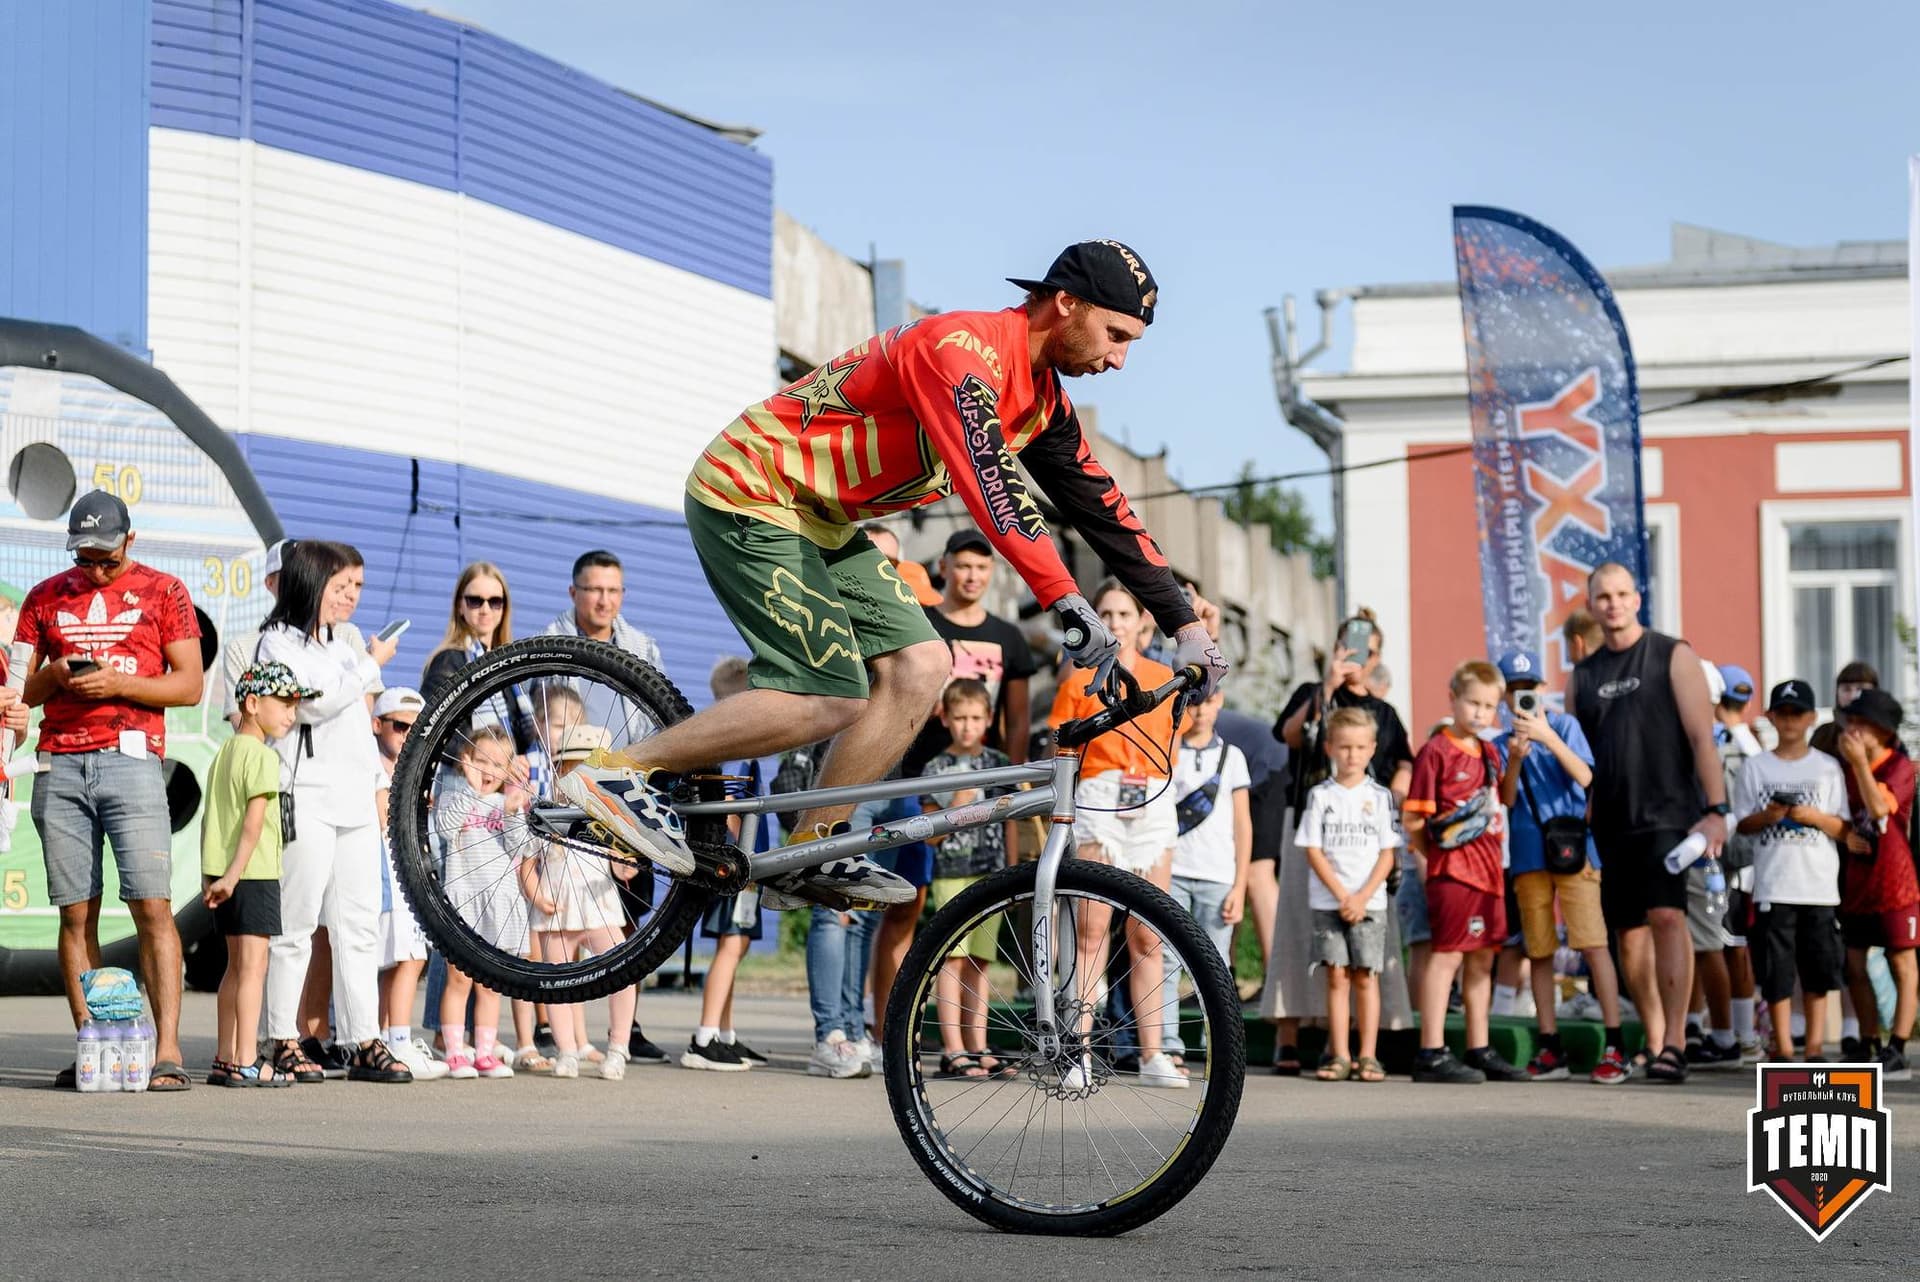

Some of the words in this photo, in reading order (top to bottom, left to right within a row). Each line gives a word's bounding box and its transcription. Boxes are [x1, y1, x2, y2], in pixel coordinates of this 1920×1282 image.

[92, 463, 143, 507] 50
[979, 465, 1020, 532] DRINK
[202, 555, 252, 600] 30
[428, 679, 470, 728] MICHELIN
[529, 651, 574, 661] ENDURO
[3, 869, 30, 911] 5
[553, 967, 608, 989] MICHELIN
[916, 1132, 937, 1161] Country
[933, 1160, 973, 1196] MICHELIN
